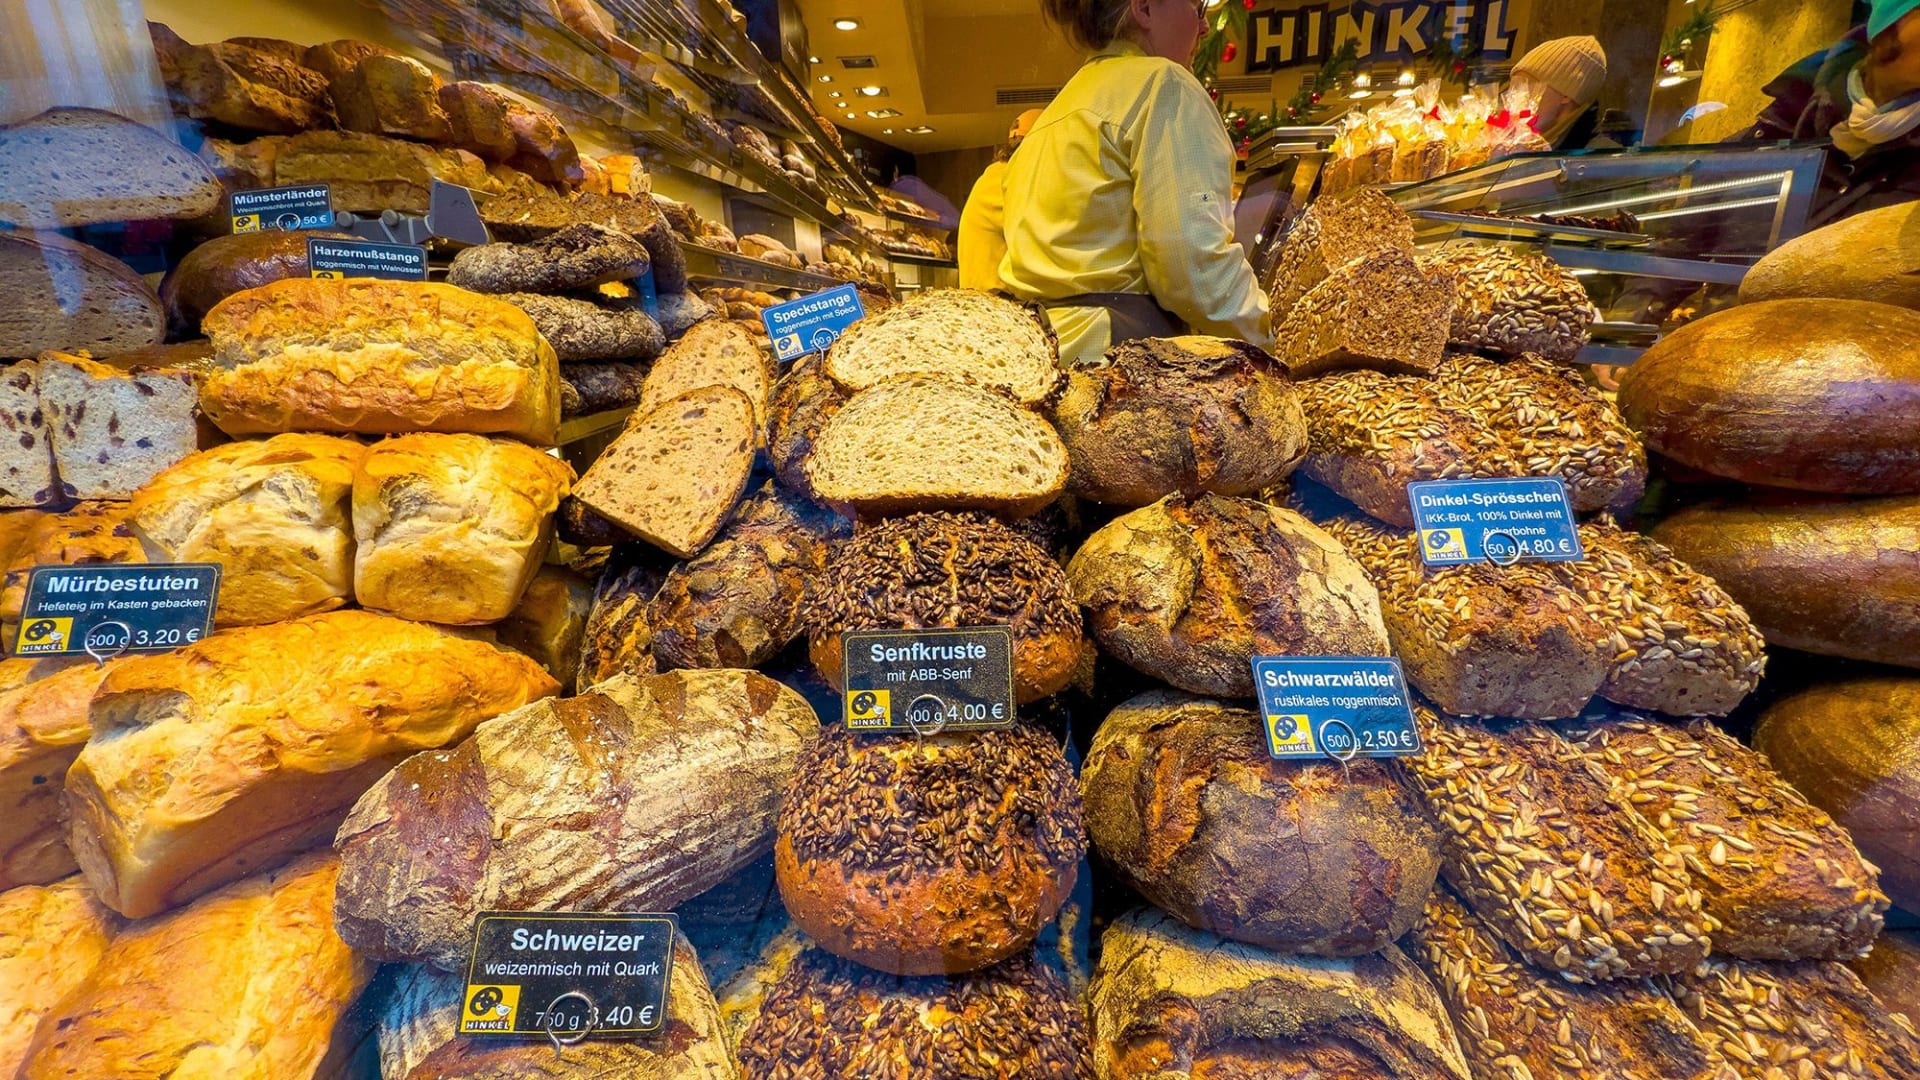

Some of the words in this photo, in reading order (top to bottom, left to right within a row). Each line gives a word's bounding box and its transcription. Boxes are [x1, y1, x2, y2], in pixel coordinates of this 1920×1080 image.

[1254, 2, 1511, 63] HINKEL
[234, 189, 327, 205] Münsterländer
[306, 200, 327, 208] Quark
[319, 214, 327, 223] €
[314, 245, 420, 264] Harzernußstange
[316, 260, 366, 271] roggenmisch
[367, 263, 380, 271] mit
[381, 264, 423, 274] Walnüssen
[773, 293, 851, 323] Speckstange
[775, 316, 822, 335] roggenmisch
[822, 311, 835, 320] mit
[835, 305, 857, 317] Speck
[1420, 491, 1562, 507] Dinkel-Sprösschen
[1425, 512, 1474, 523] IKK-Brot,
[1477, 511, 1507, 522] 100%
[1510, 510, 1543, 520] Dinkel
[1545, 509, 1563, 519] mit
[1507, 545, 1516, 556] g
[1519, 538, 1555, 556] 4,80
[1558, 538, 1571, 553] €
[47, 575, 199, 593] Mürbestuten
[38, 601, 87, 612] Hefeteig
[90, 600, 105, 610] im
[108, 600, 149, 610] Kasten
[151, 599, 207, 610] gebacken
[88, 634, 116, 646] 500
[136, 629, 181, 647] 3,20
[186, 628, 201, 643] €
[21, 643, 63, 652] HINKEL
[871, 642, 987, 662] Senfkruste
[887, 669, 907, 682] mit
[909, 667, 973, 682] ABB-Senf
[1264, 670, 1395, 687] Schwarzwälder
[1274, 694, 1330, 707] rustikales
[1332, 694, 1402, 710] roggenmisch
[934, 711, 943, 724] g
[947, 704, 986, 723] 4,00
[991, 703, 1004, 720] €
[851, 718, 888, 727] HINKEL
[1277, 743, 1313, 753] HINKEL
[1327, 734, 1350, 748] 500
[1363, 730, 1398, 750] 2,50
[1401, 730, 1413, 747] €
[511, 927, 645, 951] Schweizer
[485, 961, 582, 976] weizenmisch
[586, 961, 610, 976] mit
[614, 961, 660, 977] Quark
[465, 1020, 512, 1031] HINKEL
[569, 1014, 580, 1030] g
[586, 1005, 633, 1028] 3,40
[639, 1005, 654, 1025] €
